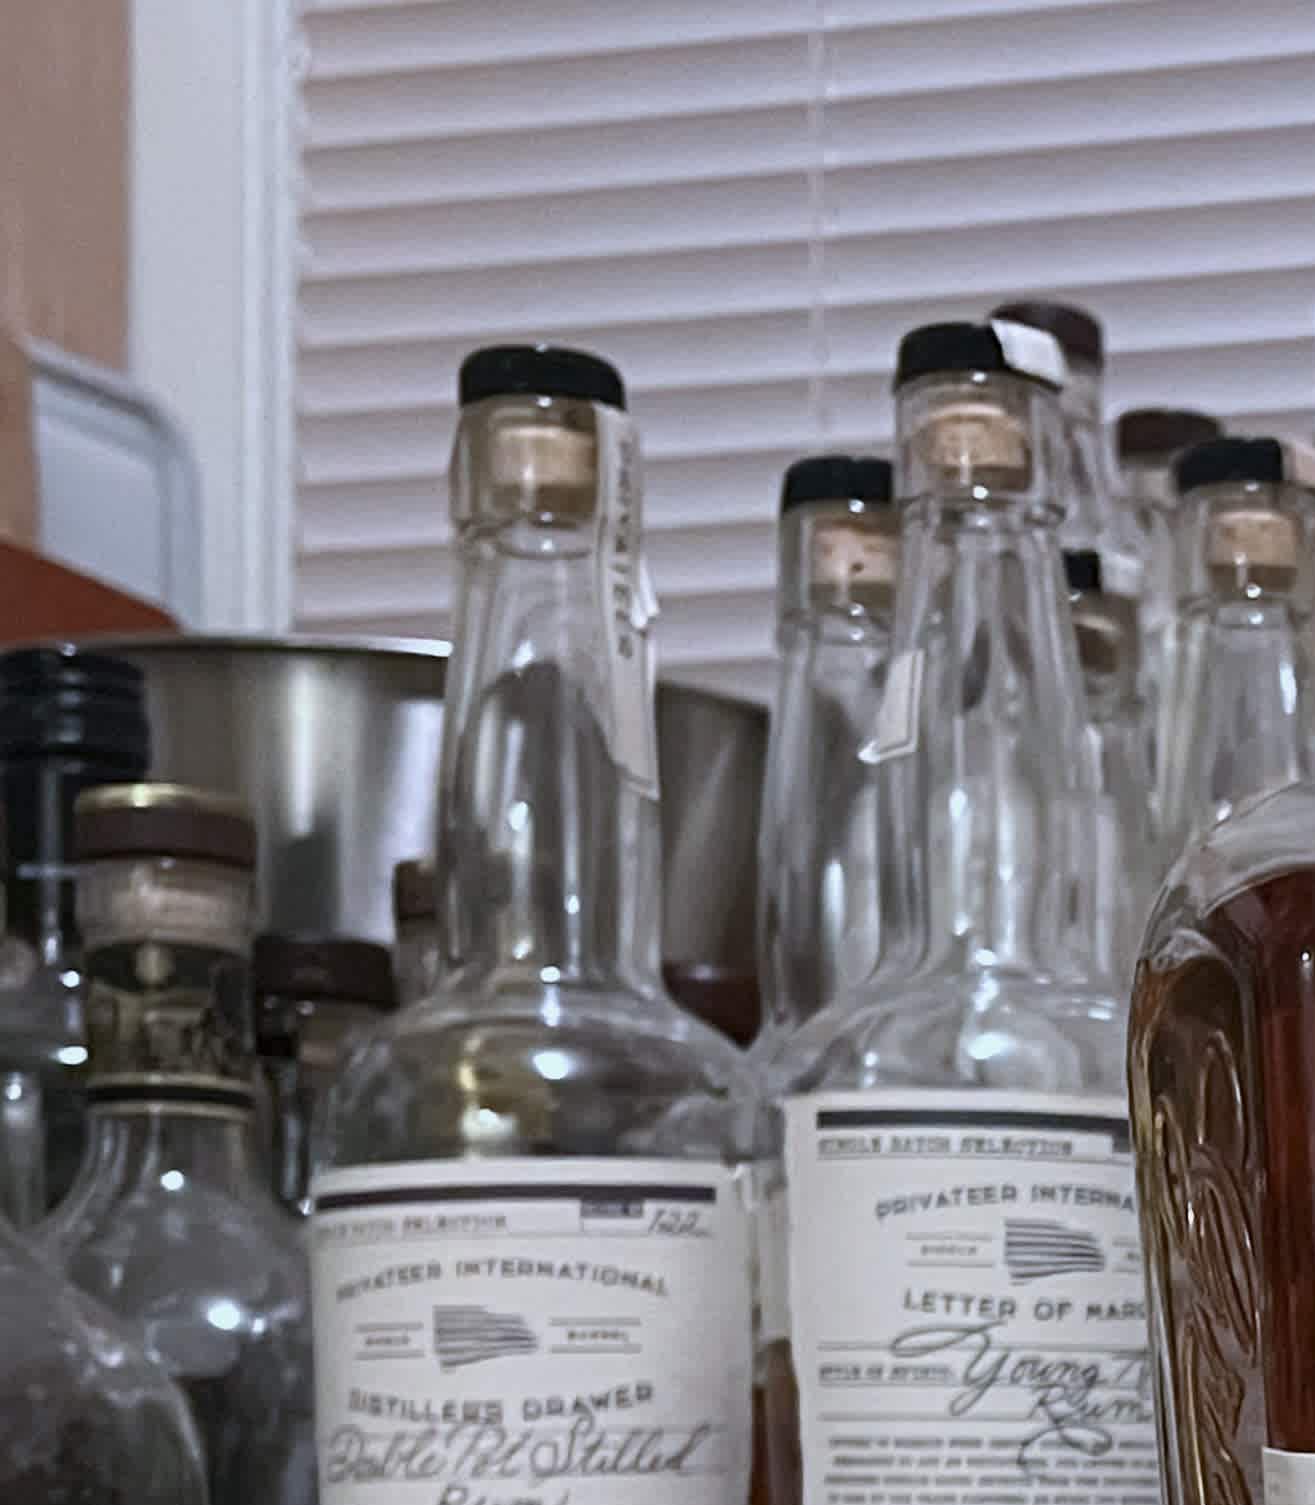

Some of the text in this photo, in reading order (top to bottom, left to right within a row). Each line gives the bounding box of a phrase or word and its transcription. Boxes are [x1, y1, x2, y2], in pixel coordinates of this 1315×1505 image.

[875, 1183, 1018, 1222] PRIVATEER
[455, 1258, 669, 1299] INTERNATIONAL
[902, 1287, 1018, 1320] LETTER
[1033, 1300, 1073, 1321] OF
[522, 1382, 655, 1422] DRAWER
